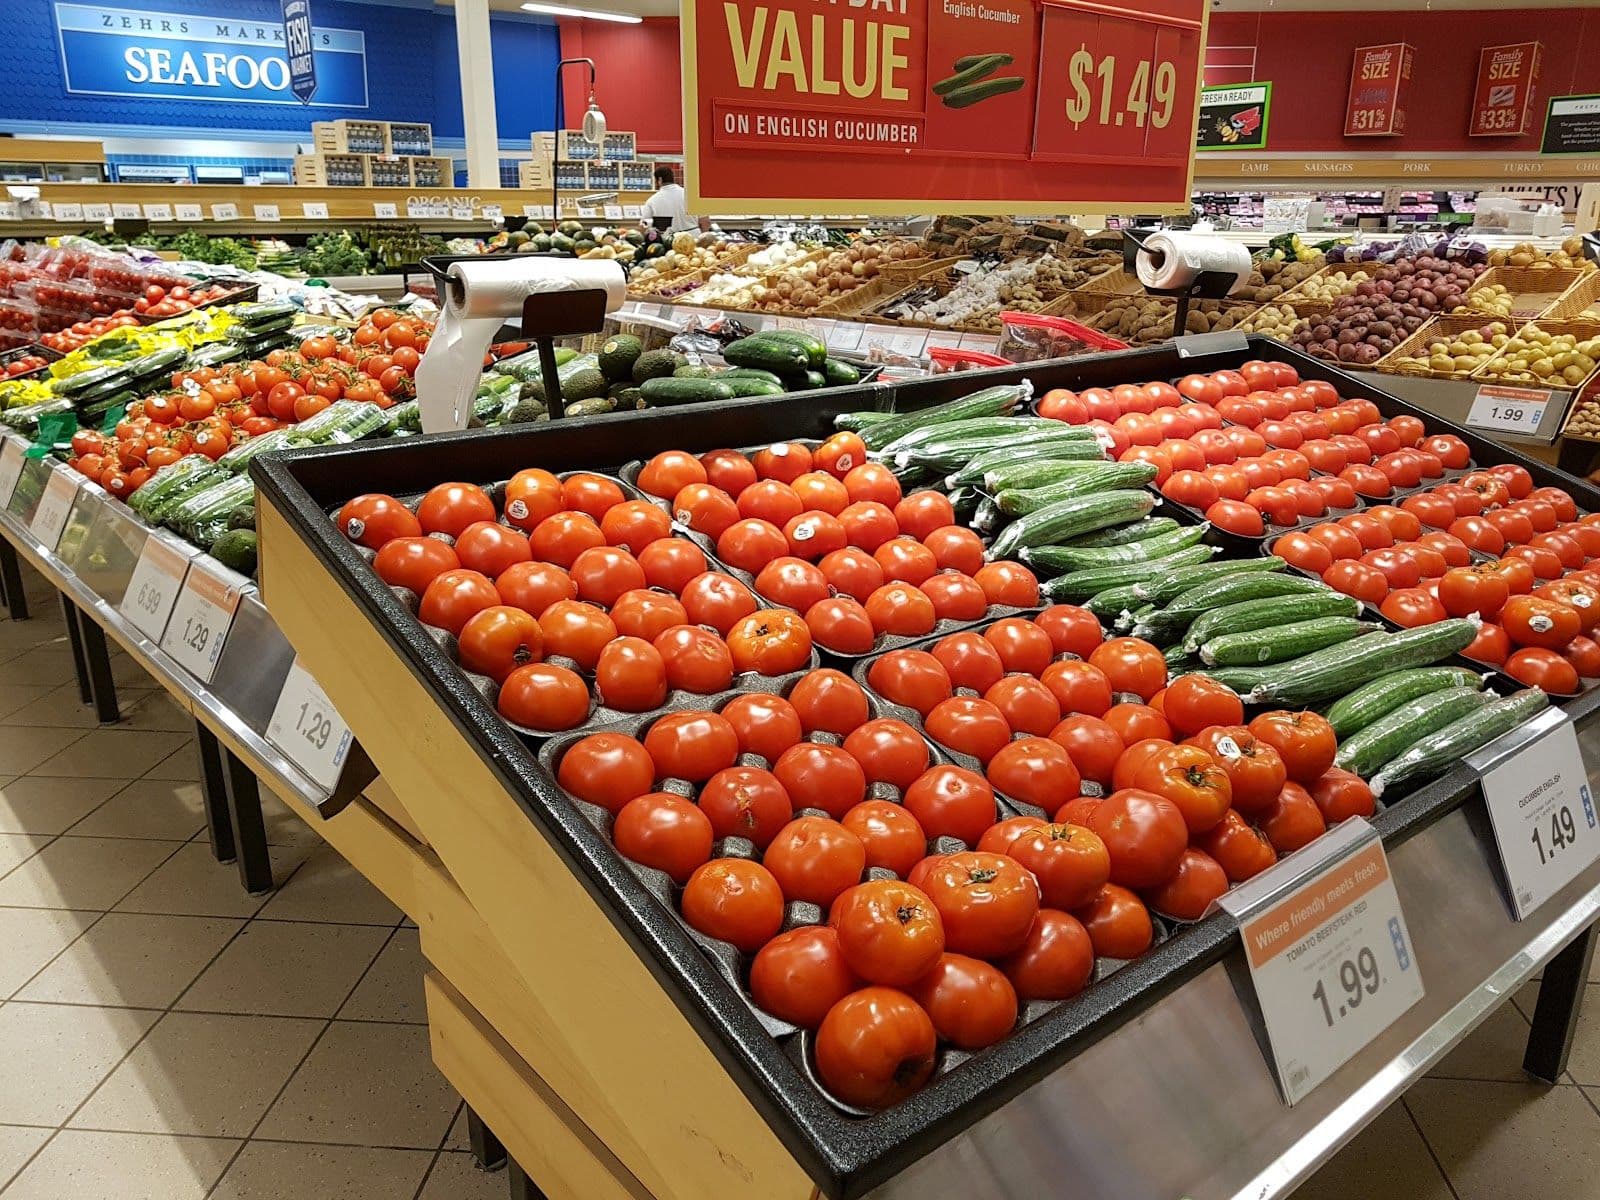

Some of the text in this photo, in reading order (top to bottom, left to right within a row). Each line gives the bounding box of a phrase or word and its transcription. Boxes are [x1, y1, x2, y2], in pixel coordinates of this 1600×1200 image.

[943, 0, 1020, 24] English Cucumber
[102, 15, 330, 45] ZEHRS MARKS
[286, 16, 311, 57] FISH
[723, 2, 910, 101] VALUE
[1365, 49, 1392, 62] Family
[1492, 49, 1523, 62] Family
[123, 47, 291, 91] SEAFOO
[1361, 62, 1390, 80] SIZE
[1489, 62, 1521, 80] SIZE
[1066, 43, 1176, 131] $1.49
[1200, 92, 1223, 103] FRESH
[1229, 90, 1253, 101] READY
[724, 112, 918, 144] ON ENGLISH CUCUMBER
[1241, 163, 1269, 172] LAMB
[1304, 163, 1354, 173] SAUSAGES
[1403, 163, 1431, 172] PORK
[1503, 163, 1544, 172] TURKEY
[1491, 407, 1524, 421] 1.99
[137, 583, 162, 615] 6.99
[183, 617, 209, 653] 1.29
[296, 702, 332, 750] 1.29
[1531, 806, 1576, 865] 1.49
[1255, 861, 1381, 949] Where friendly meets fresh.
[1287, 937, 1316, 963] TOMATO
[1317, 912, 1354, 942] BEEFSTEAK
[1354, 901, 1368, 914] RED
[1312, 947, 1380, 1027] 1.99
